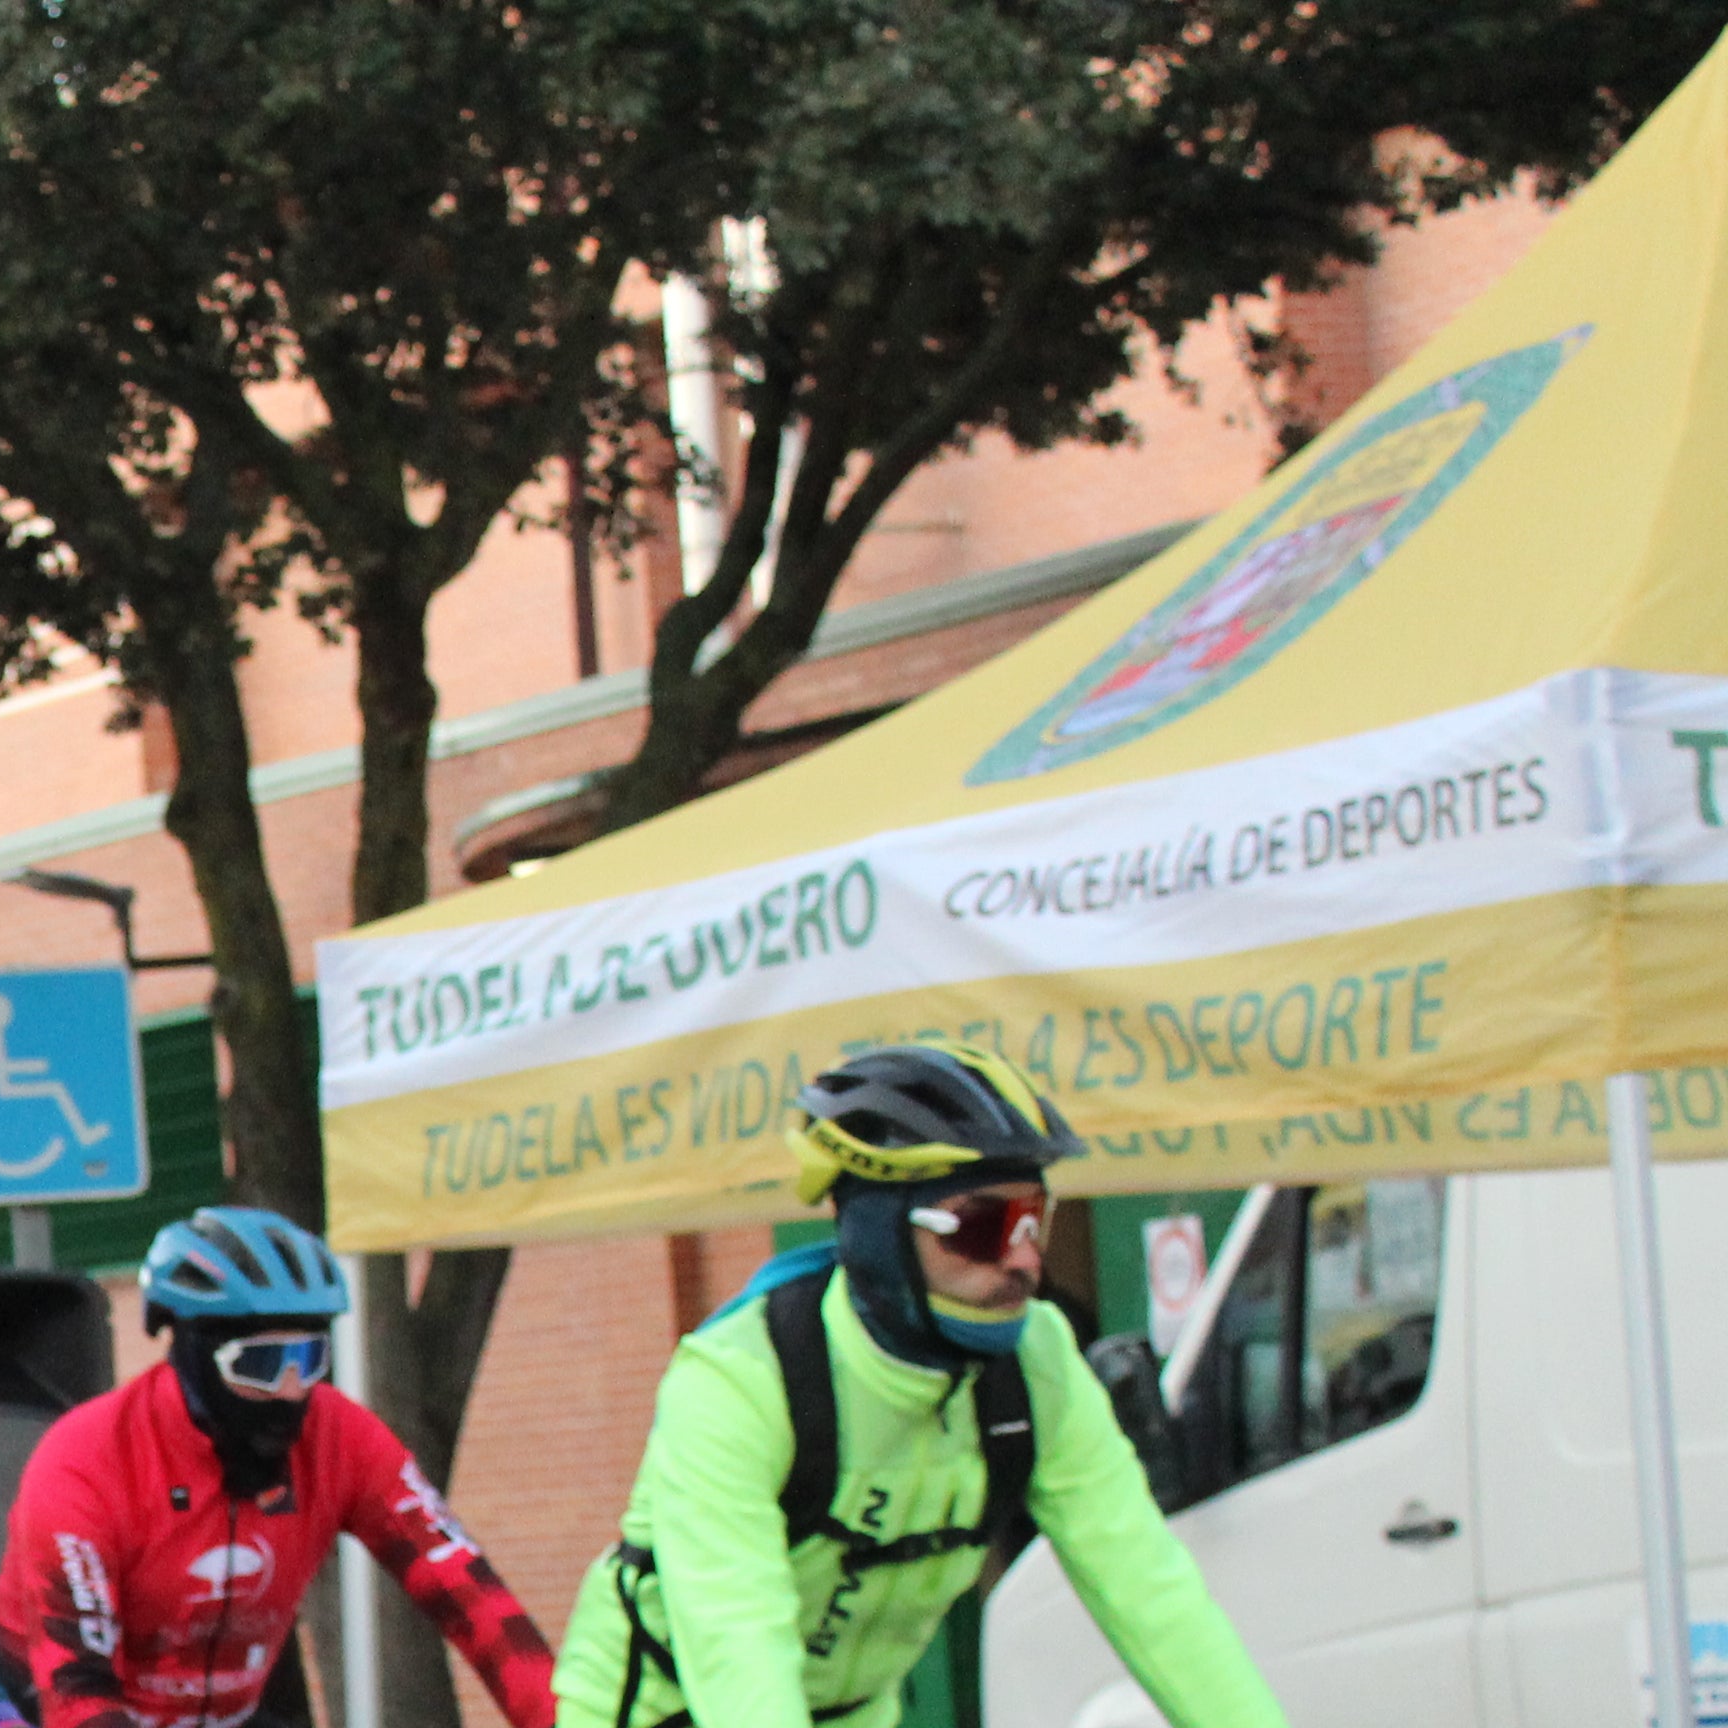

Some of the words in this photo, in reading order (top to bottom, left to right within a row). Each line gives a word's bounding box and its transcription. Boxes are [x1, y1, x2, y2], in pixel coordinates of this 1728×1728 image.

[945, 823, 1215, 920] CONCEJALÍA
[1229, 816, 1290, 885] DE
[1302, 757, 1551, 870] DEPORTES
[1074, 1008, 1145, 1091] ES
[1149, 960, 1448, 1083] DEPORTE
[422, 1092, 610, 1198] TUDELA
[618, 1078, 676, 1164] ES
